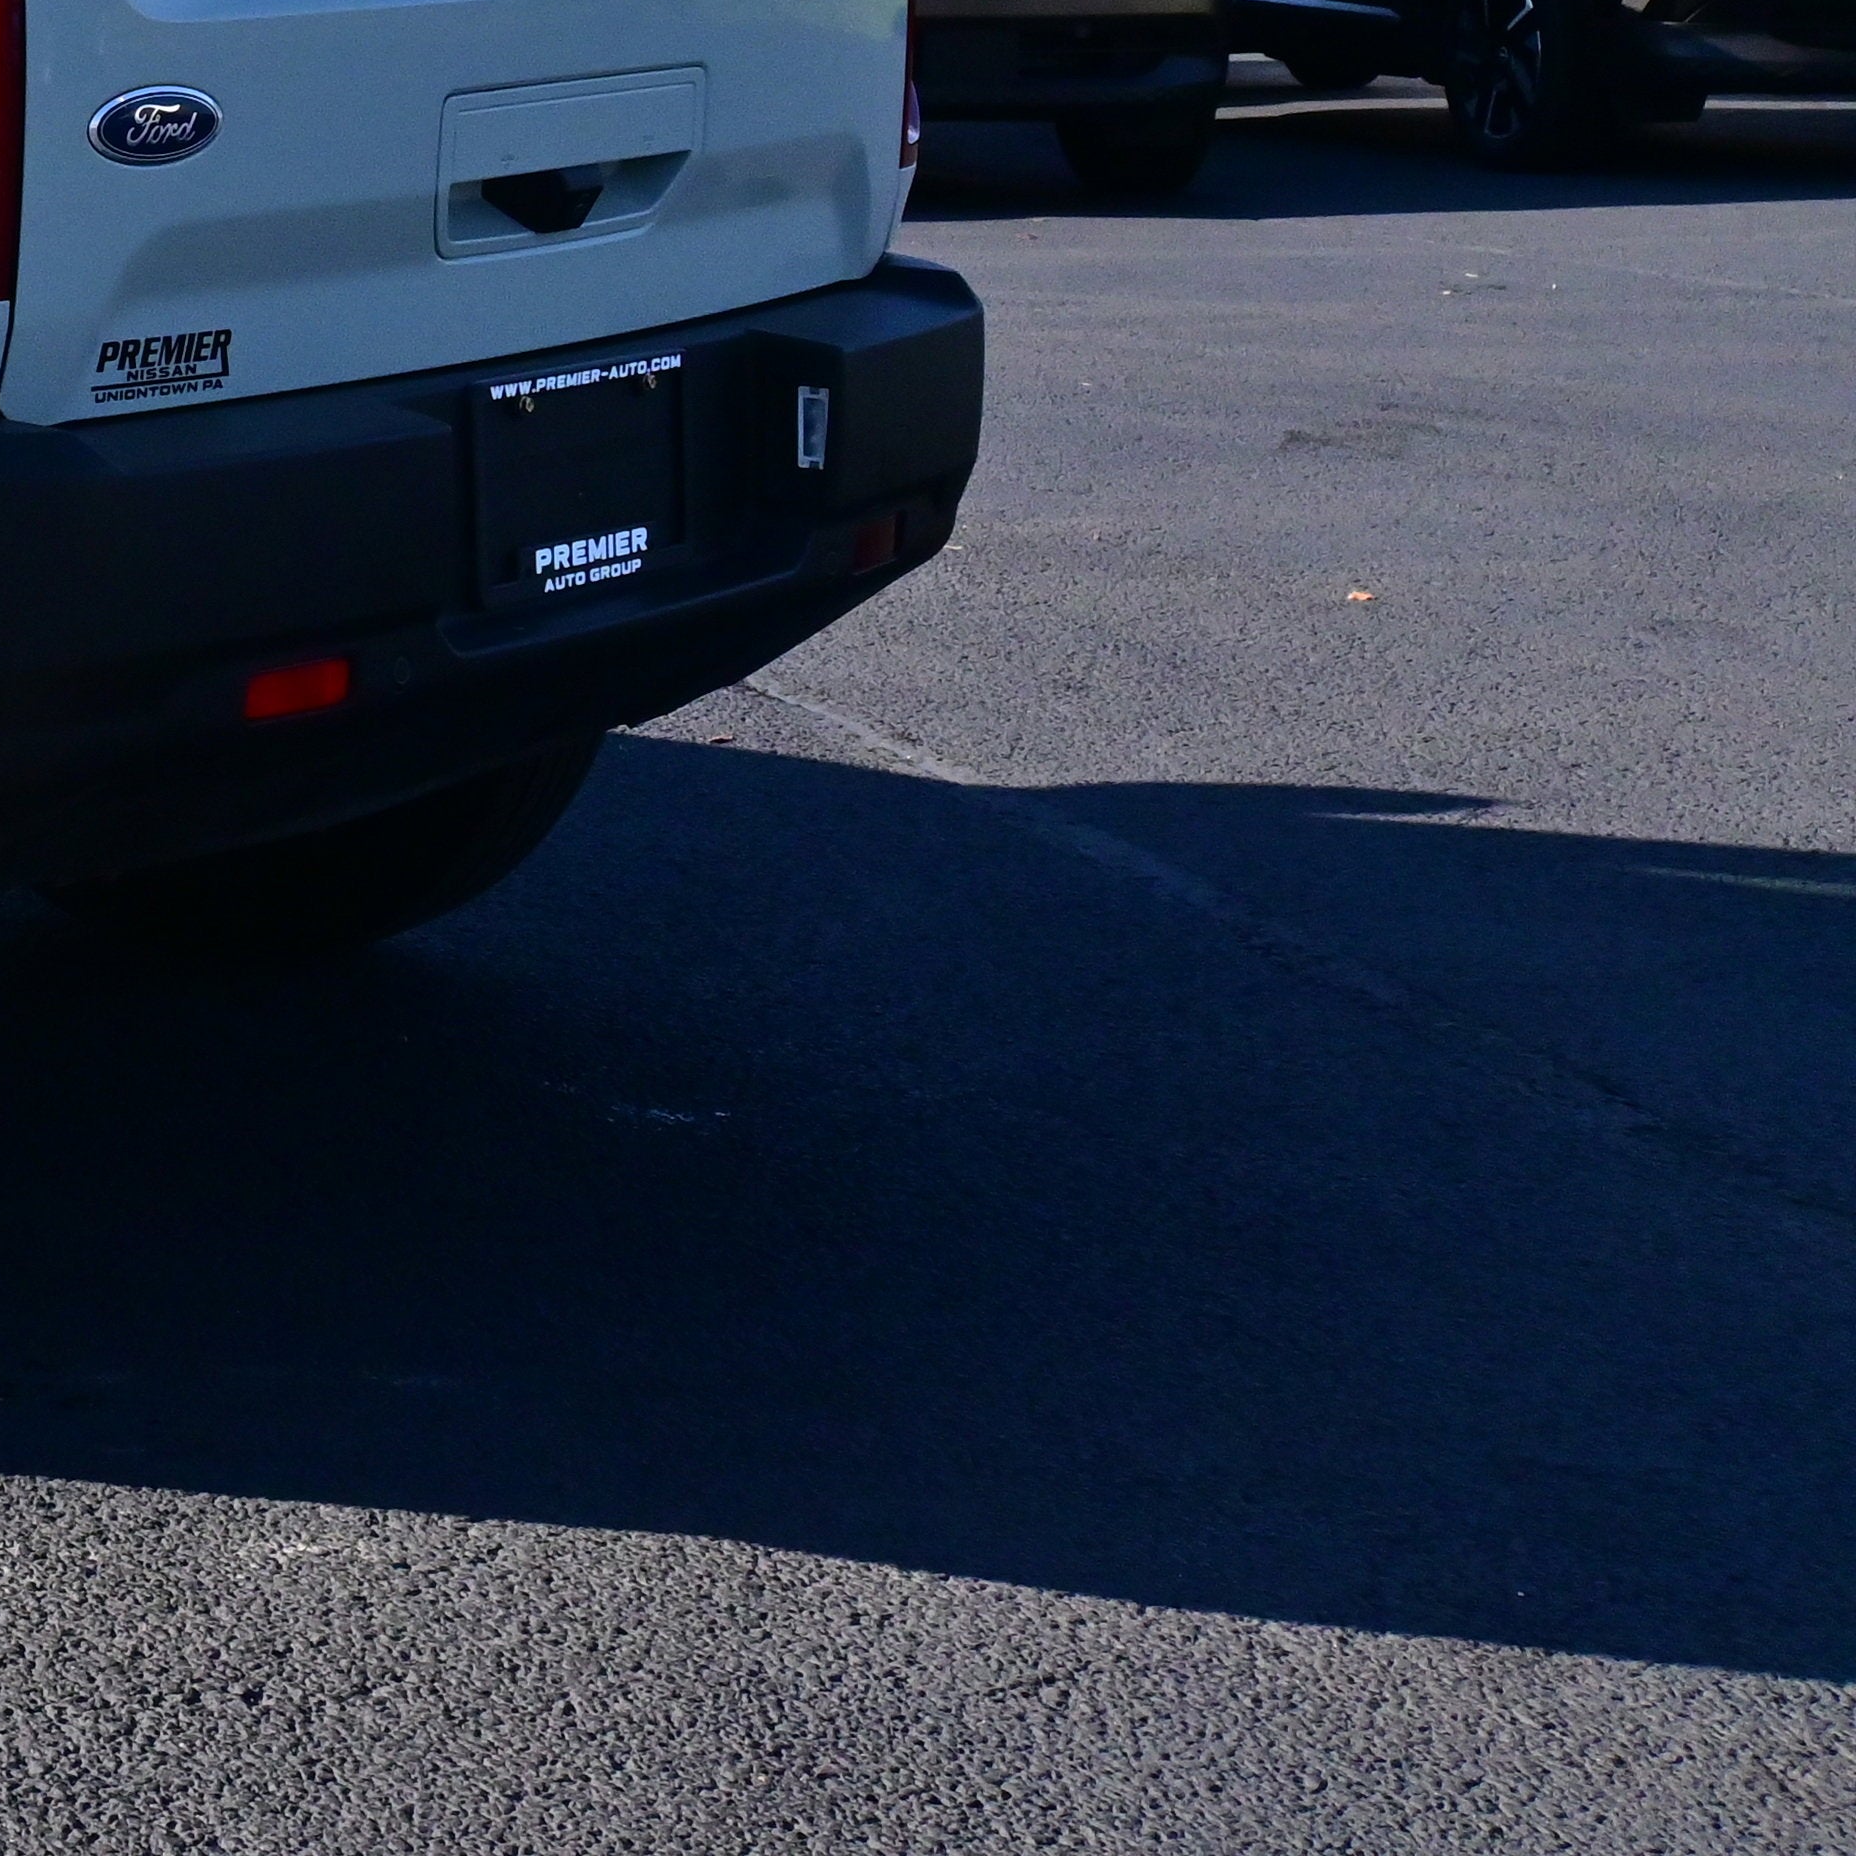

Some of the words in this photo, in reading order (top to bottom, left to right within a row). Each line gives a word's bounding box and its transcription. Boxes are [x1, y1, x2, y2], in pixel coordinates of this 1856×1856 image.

[127, 104, 198, 146] Ford
[96, 329, 232, 373] PREMIER
[94, 382, 198, 404] UNIONTOWN
[202, 379, 224, 391] PA
[126, 364, 197, 381] NISSAN
[490, 354, 682, 400] WWW.PREMIER-AUTO.COM
[535, 527, 648, 574] PREMIER
[544, 571, 586, 593] AUTO
[589, 558, 642, 582] GROUP
